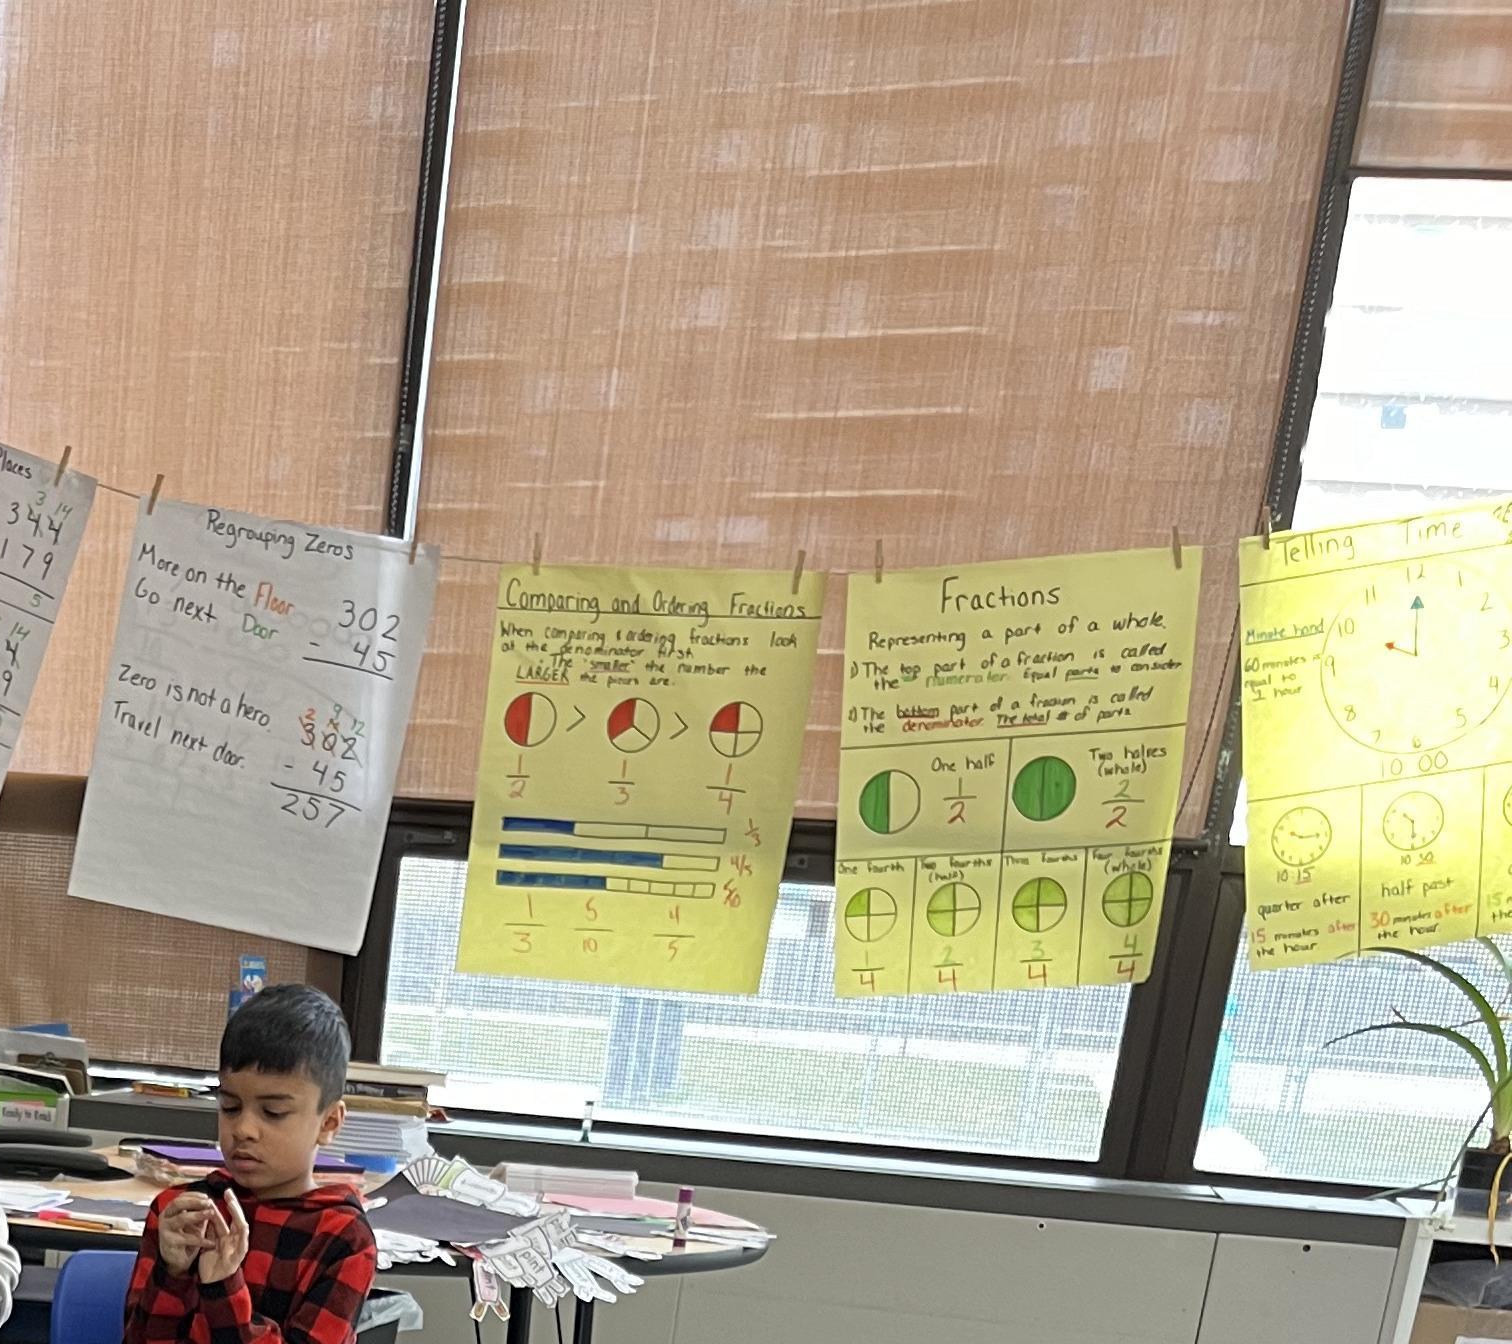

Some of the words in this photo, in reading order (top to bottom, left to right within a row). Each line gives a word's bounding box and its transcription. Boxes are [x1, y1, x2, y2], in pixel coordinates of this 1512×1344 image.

[206, 509, 295, 559] Regrouping
[305, 533, 354, 561] Zeros
[1276, 533, 1355, 565] Telling
[1398, 516, 1462, 544] Time
[138, 543, 180, 577] More
[185, 569, 208, 585] on
[217, 573, 246, 598] the
[254, 581, 295, 615] Floor
[1407, 564, 1425, 583] 12
[507, 578, 600, 624] Comparing
[612, 593, 640, 613] and
[653, 590, 709, 627] Ordering
[730, 592, 806, 618] Fractions
[941, 576, 1061, 613] Fractions
[135, 577, 160, 604] Go
[174, 596, 217, 622] next
[242, 613, 279, 639] Door
[338, 600, 400, 642] 302
[1246, 629, 1285, 642] Minute
[1294, 618, 1324, 636] hand
[1338, 618, 1354, 637] 10
[500, 620, 533, 637] When
[545, 626, 605, 647] comparing
[626, 630, 676, 650] ordering
[690, 627, 749, 646] fractions
[770, 631, 797, 648] look
[869, 631, 966, 651] Representing
[982, 629, 992, 639] a
[1005, 623, 1041, 645] part
[1058, 616, 1079, 634] of
[1088, 621, 1100, 632] a
[502, 640, 514, 652] at
[526, 641, 547, 652] the
[560, 645, 644, 657] denominator
[550, 652, 573, 668] The
[645, 661, 664, 672] the
[678, 663, 730, 675] number
[745, 664, 766, 676] the
[862, 661, 889, 678] The
[900, 663, 921, 680] top
[934, 658, 965, 676] part
[981, 652, 998, 669] of
[1001, 658, 1010, 668] a
[1018, 650, 1074, 665] fraction
[1093, 649, 1104, 659] is
[1121, 642, 1167, 659] called
[1245, 656, 1259, 672] 60
[1262, 655, 1306, 669] minutes
[516, 665, 568, 683] LARGER
[580, 673, 597, 683] the
[874, 677, 899, 690] the
[1065, 667, 1099, 682] parts
[1245, 674, 1271, 689] equal
[1282, 674, 1296, 682] to
[118, 664, 156, 690] Zero
[166, 683, 183, 702] is
[188, 687, 216, 706] not
[220, 699, 231, 714] a
[236, 692, 271, 733] hero.
[861, 707, 885, 721] The
[950, 703, 978, 721] part
[990, 696, 1003, 711] of
[1011, 701, 1020, 710] a
[1088, 695, 1098, 705] is
[1111, 686, 1154, 703] called
[1274, 686, 1301, 698] hour
[864, 724, 885, 733] the
[1074, 706, 1090, 721] of
[114, 701, 161, 739] Travel
[170, 727, 207, 748] next
[213, 744, 244, 768] door.
[931, 757, 957, 772] One
[965, 754, 995, 769] half
[1088, 747, 1113, 761] Two
[1123, 746, 1167, 760] halves
[1097, 760, 1147, 778] (whole)
[281, 793, 345, 828] 257
[1381, 879, 1414, 897] half
[1423, 877, 1454, 897] past
[1258, 901, 1303, 920] quarter
[1313, 893, 1351, 907] after
[1370, 911, 1389, 928] 30
[1435, 903, 1473, 919] after
[1252, 928, 1265, 943] 15
[1378, 930, 1399, 940] the
[1410, 923, 1438, 935] hour
[1257, 947, 1274, 957] the
[1284, 943, 1318, 953] hour
[523, 1251, 544, 1274] pint
